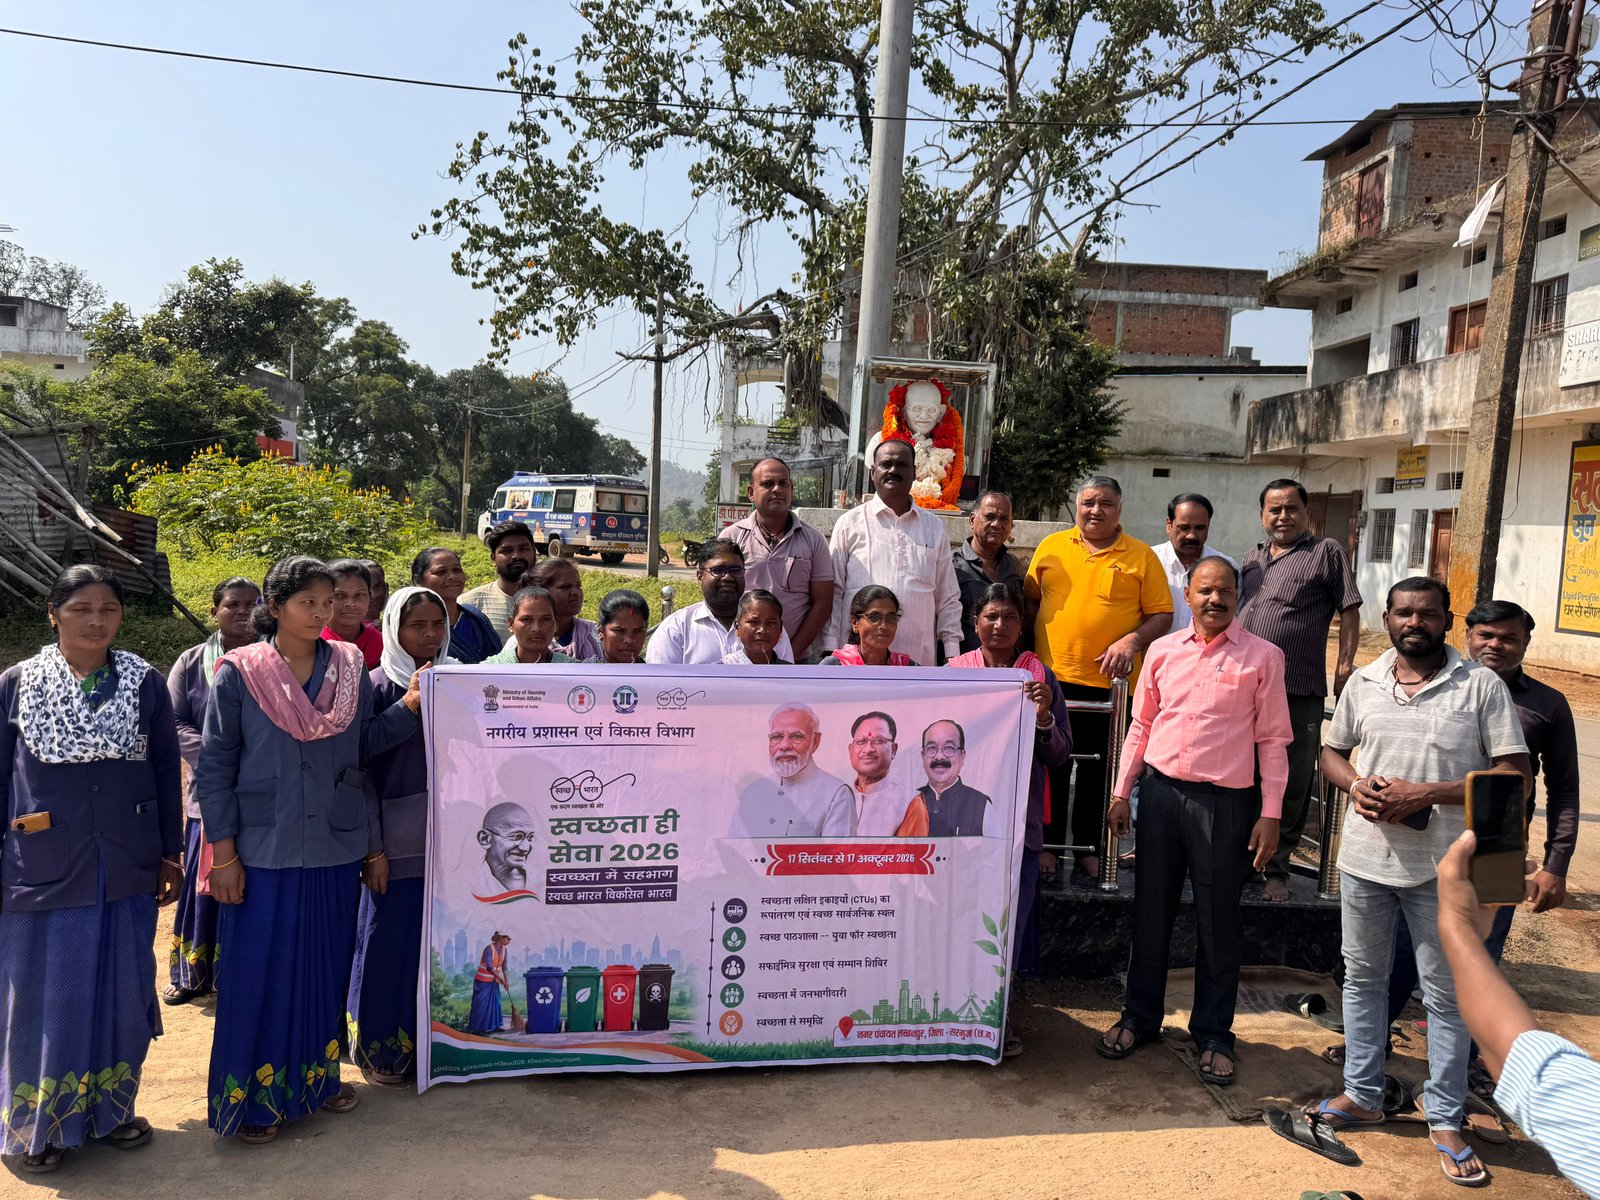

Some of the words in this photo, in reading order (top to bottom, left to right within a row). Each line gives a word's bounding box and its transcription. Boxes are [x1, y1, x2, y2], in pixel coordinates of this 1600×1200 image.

[1568, 326, 1600, 348] SHAR
[1578, 592, 1599, 602] Profile
[486, 723, 526, 739] नगरीय
[532, 726, 578, 739] प्रशासन
[584, 722, 603, 740] एवं
[609, 722, 651, 738] विकास
[657, 722, 695, 738] विभाग
[549, 815, 649, 836] स्वच्छता
[654, 808, 680, 834] ही
[548, 840, 604, 863] सेवा
[610, 842, 679, 862] 2026
[788, 854, 796, 863] 17
[798, 852, 833, 863] सितंबर
[835, 852, 845, 863] से
[847, 854, 855, 863] 17
[857, 854, 895, 866] अक्टूबर
[896, 854, 914, 863] 2026
[549, 872, 600, 882] स्वच्छता
[605, 868, 618, 880] में
[623, 869, 674, 880] सहभाग
[548, 892, 573, 901] स्वच्छ
[577, 891, 602, 900] भारत
[606, 887, 644, 900] विकसित
[648, 889, 672, 898] भारत
[761, 897, 792, 905] स्वच्छता
[794, 894, 817, 905] लक्षित
[850, 896, 877, 905] (CTUs)
[760, 909, 795, 920] रूपांतरण
[798, 908, 810, 920] एवं
[812, 910, 833, 918] स्वच्छ
[836, 907, 875, 918] सार्वजनिक
[878, 909, 895, 918] स्थल
[760, 933, 781, 941] स्वच्छ
[784, 932, 818, 940] पाठशाला
[832, 932, 847, 942] युवा
[850, 929, 865, 939] फॉर
[867, 930, 897, 939] स्वच्छता
[758, 959, 796, 971] सफाईमित्र
[798, 960, 820, 972] सुरक्षा
[823, 957, 834, 970] एवं
[837, 959, 862, 968] सम्मान
[864, 957, 888, 968] शिविर
[757, 991, 788, 1000] स्वच्छता
[800, 987, 847, 999] जनभागीदारी
[756, 1018, 786, 1027] स्वच्छता
[789, 1015, 796, 1026] से
[799, 1014, 824, 1027] समृद्धि
[857, 1030, 873, 1039] नगर
[874, 1029, 896, 1039] पंचायत
[928, 1027, 944, 1038] जिला
